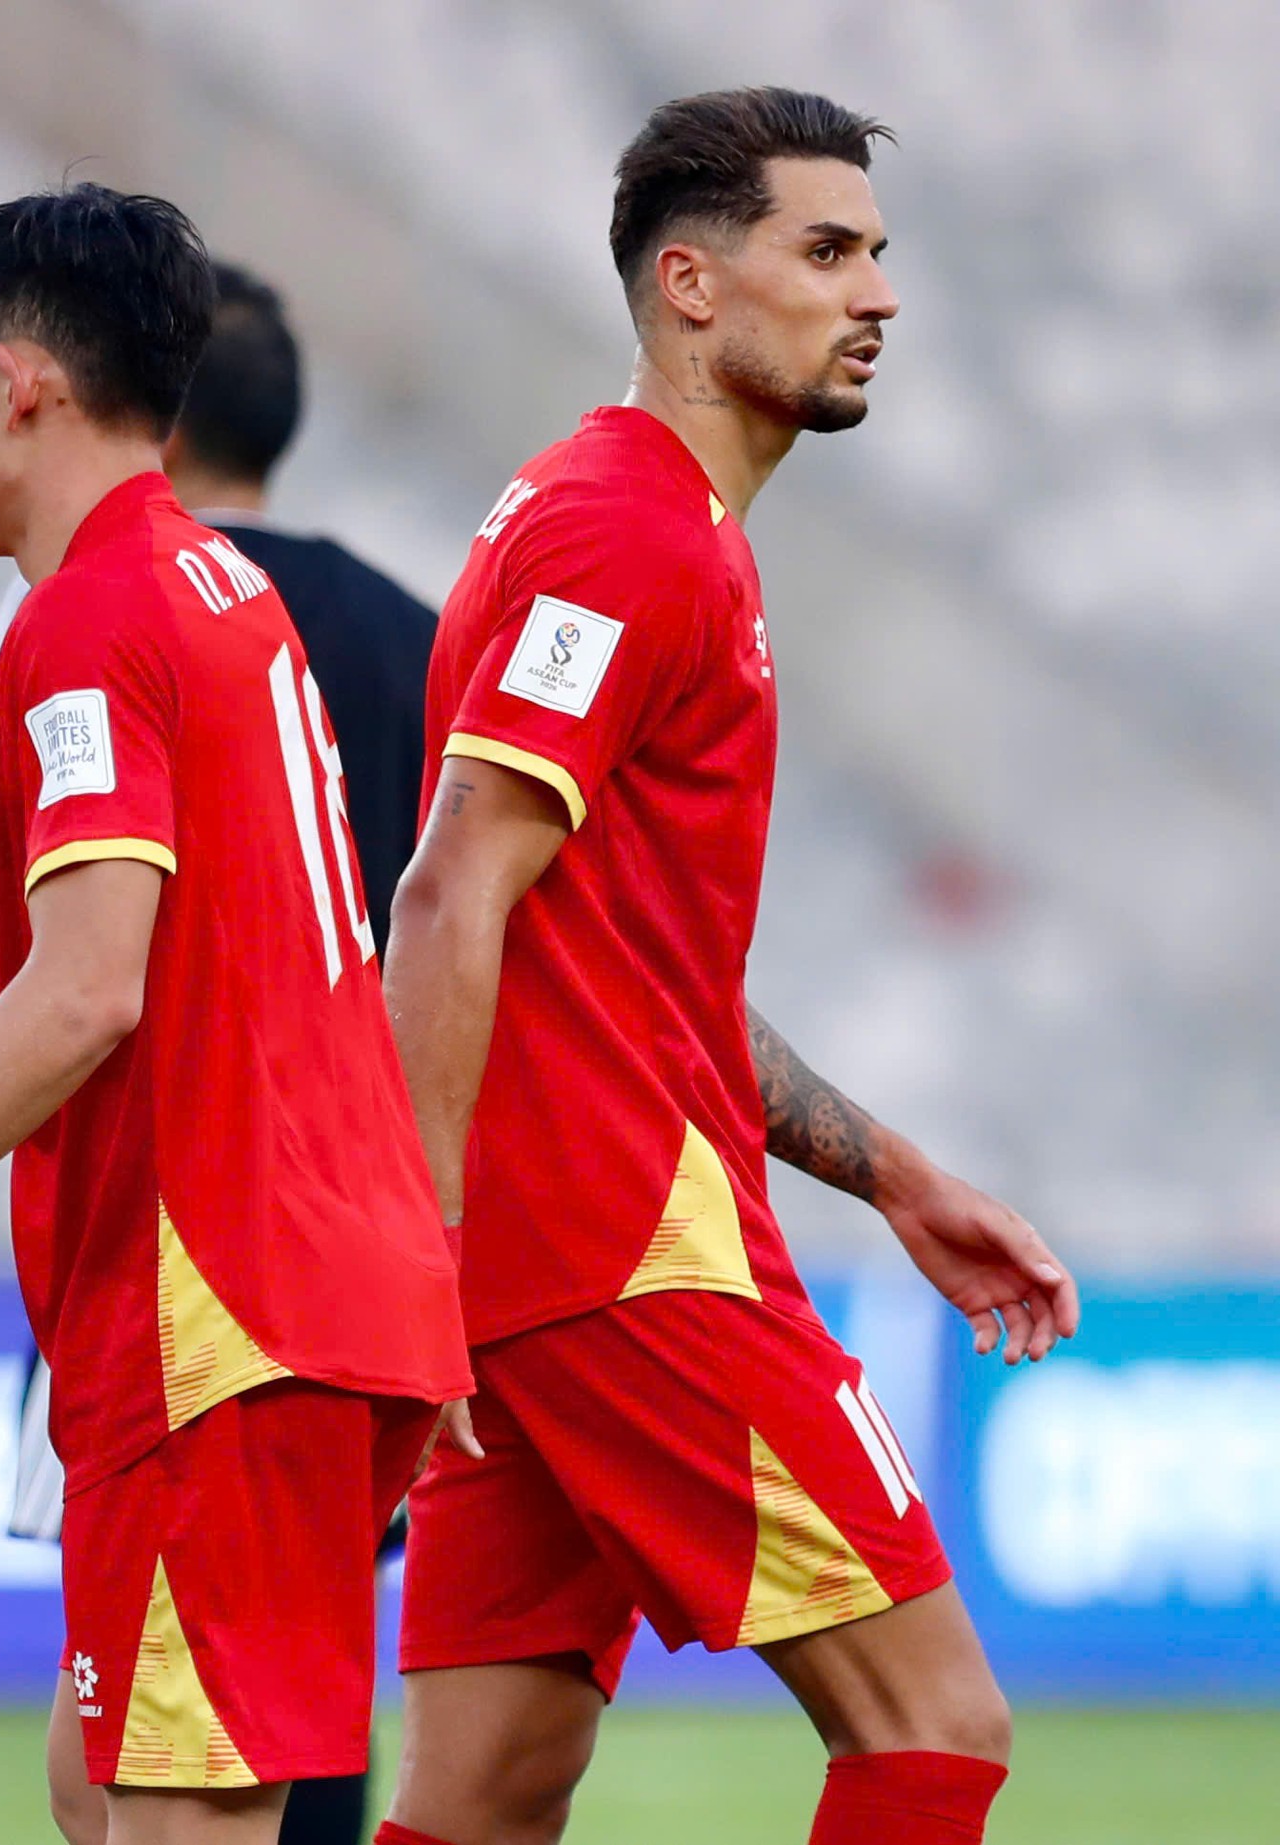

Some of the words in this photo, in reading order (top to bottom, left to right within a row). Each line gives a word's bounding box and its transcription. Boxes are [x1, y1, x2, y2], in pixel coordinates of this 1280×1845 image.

[526, 666, 559, 683] ASEAN
[558, 678, 578, 690] CUP
[545, 663, 565, 678] FIFA
[43, 709, 89, 737] FBALL
[57, 747, 96, 767] World
